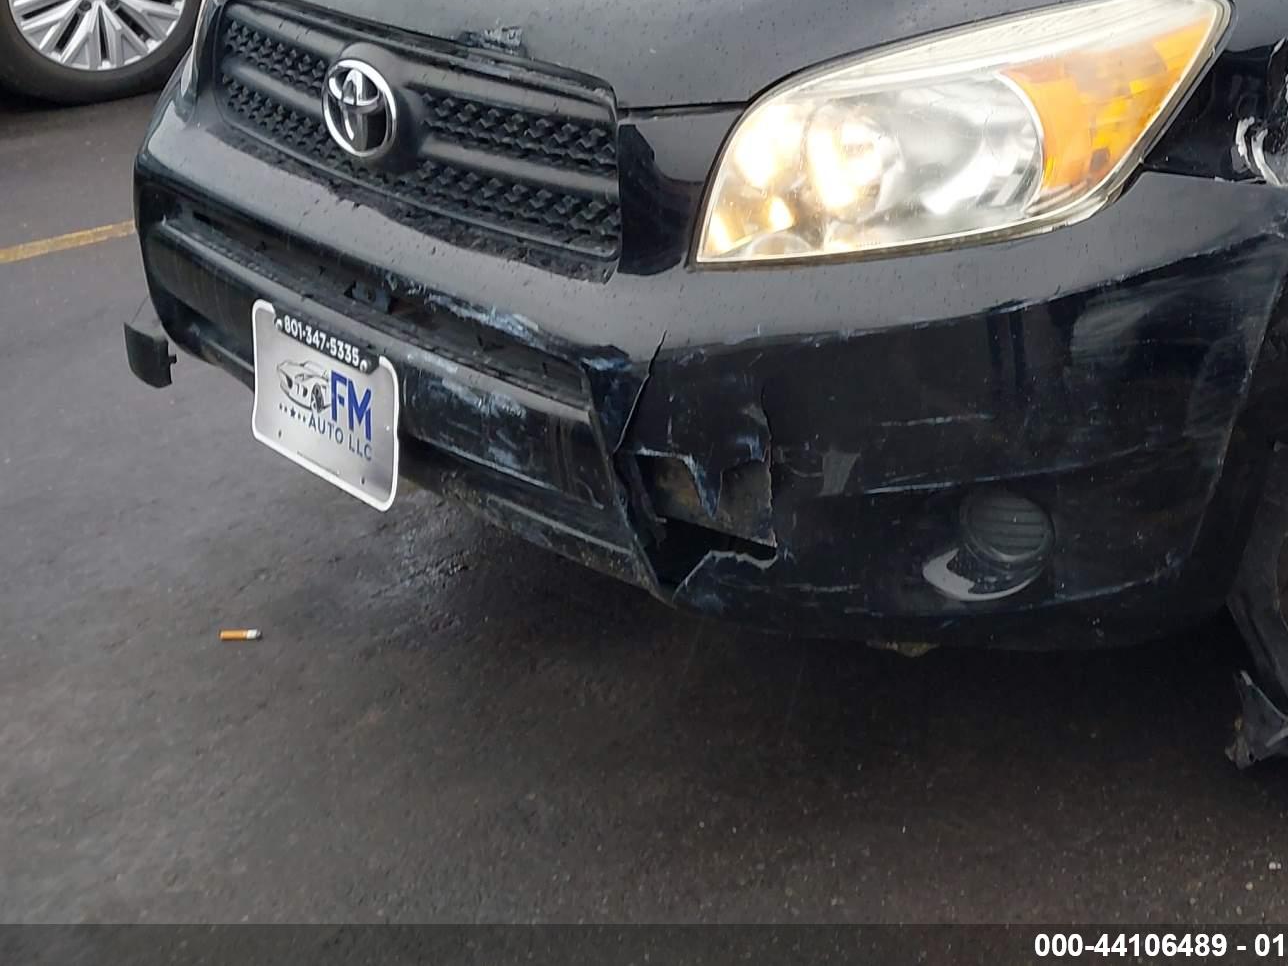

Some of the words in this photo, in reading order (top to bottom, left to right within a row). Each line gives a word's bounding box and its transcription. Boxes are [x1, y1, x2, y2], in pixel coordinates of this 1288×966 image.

[331, 369, 372, 442] FM
[308, 414, 344, 445] AUTO
[349, 433, 373, 461] LLC
